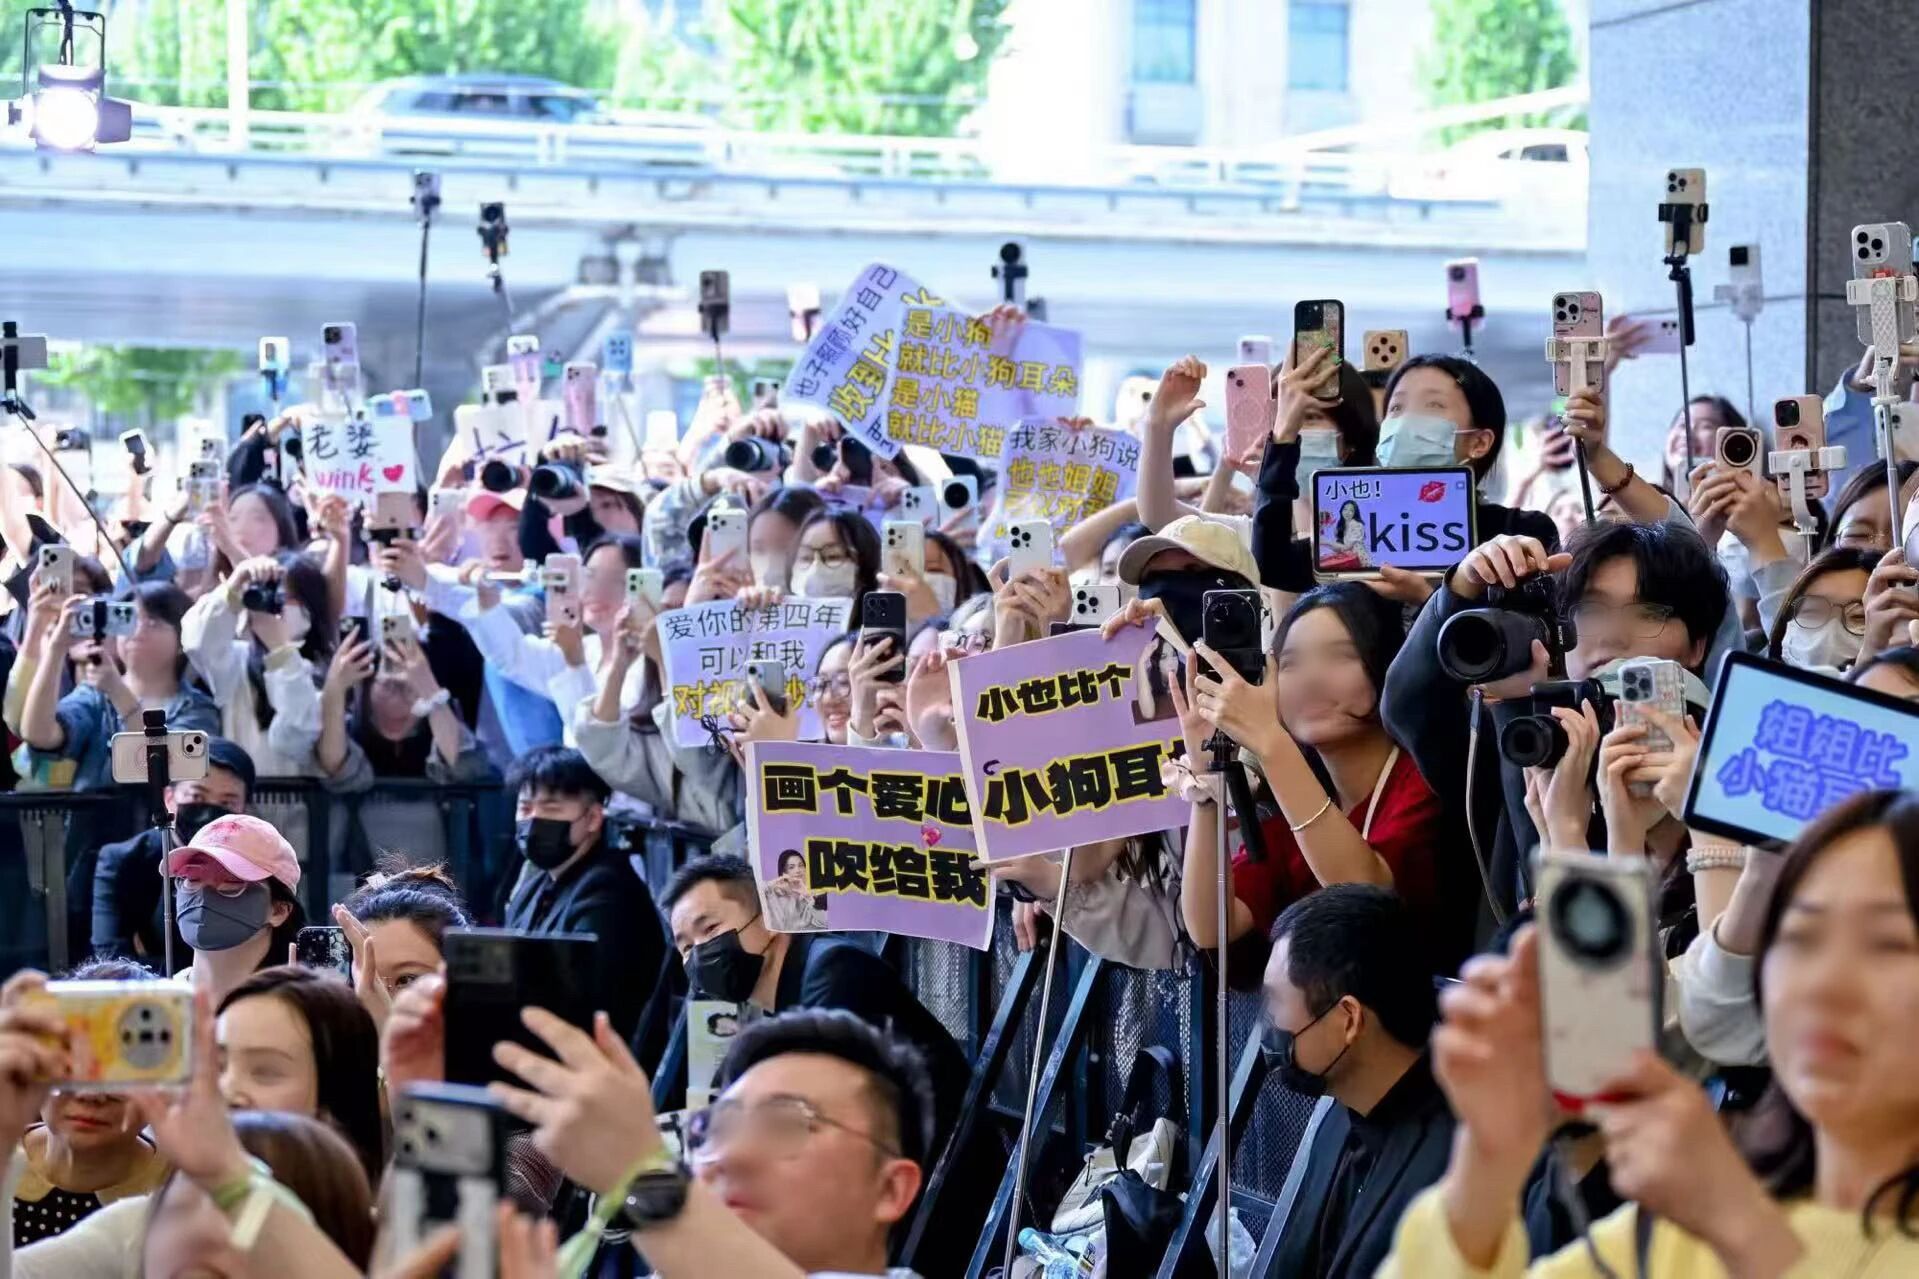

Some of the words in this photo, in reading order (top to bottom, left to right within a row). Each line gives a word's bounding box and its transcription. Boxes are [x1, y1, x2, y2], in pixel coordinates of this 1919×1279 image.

[904, 308, 994, 349] 是小狗
[896, 341, 1078, 397] 就比小狗耳朵
[890, 377, 980, 418] 是小猫
[307, 424, 382, 460] 老婆
[887, 408, 1006, 457] 就比小猫
[1010, 425, 1141, 472] 我家小狗说
[314, 463, 375, 494] wink
[1368, 512, 1467, 553] kiss
[665, 603, 843, 641] 爱你的第四年
[698, 640, 806, 675] 可以和我
[975, 663, 1133, 722] 小也比个
[1753, 699, 1909, 787] 姐姐比
[762, 762, 974, 826] 画个爱心
[804, 838, 989, 909] 吹给我
